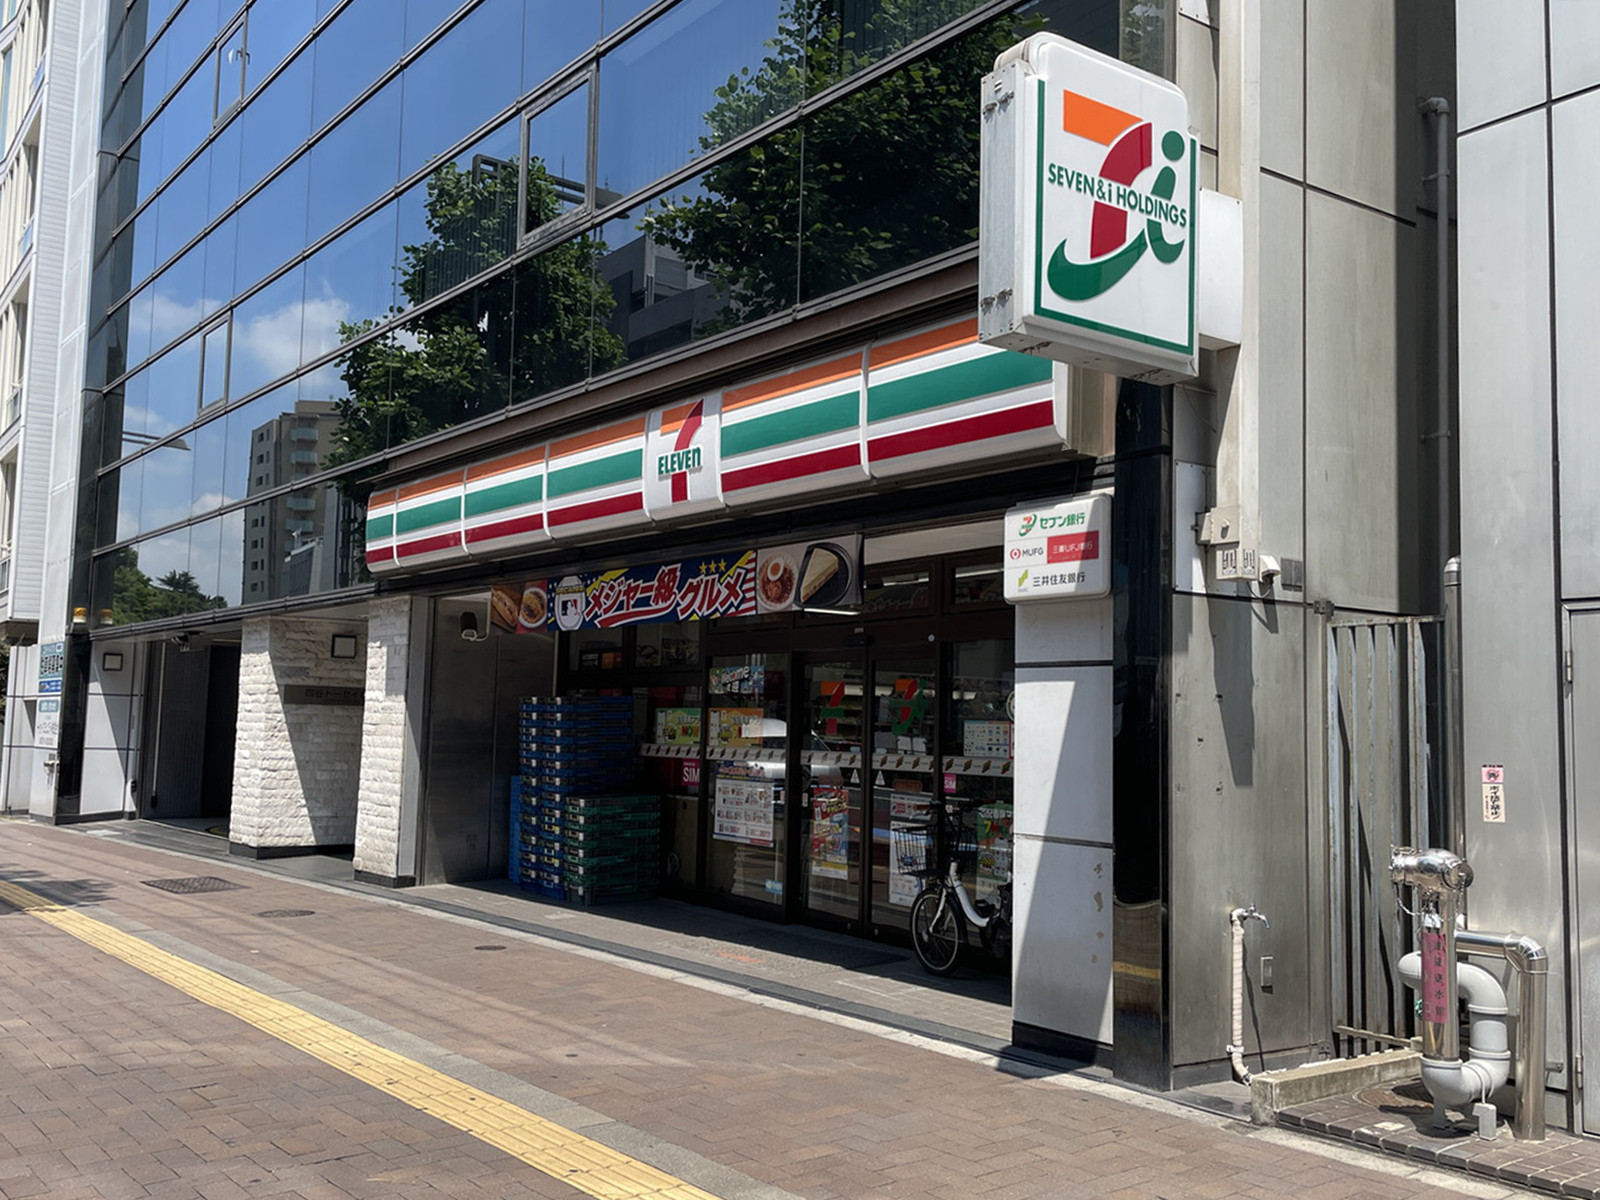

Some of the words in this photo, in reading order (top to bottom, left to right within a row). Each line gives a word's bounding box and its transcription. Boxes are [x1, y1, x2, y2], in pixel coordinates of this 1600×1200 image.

[1047, 162, 1113, 207] SEVEN&i
[1115, 186, 1188, 229] HOLDINGS
[1039, 512, 1085, 529] セブン銀行
[1022, 547, 1044, 557] MUFG
[1052, 540, 1093, 554] 三菱UFJ銀行
[1032, 572, 1086, 588] 三井住友銀行
[583, 562, 746, 623] メジャー級グルメ
